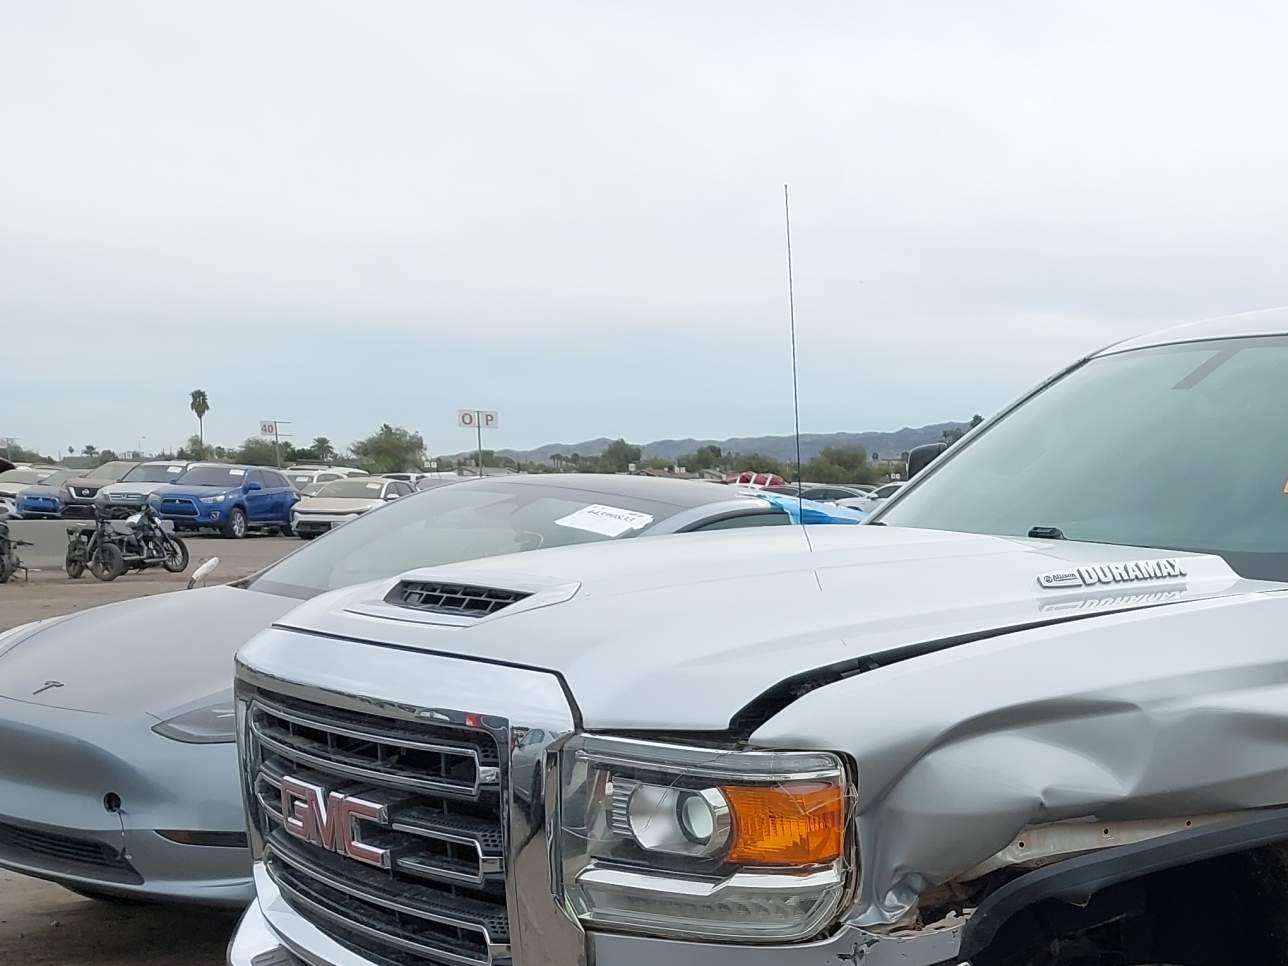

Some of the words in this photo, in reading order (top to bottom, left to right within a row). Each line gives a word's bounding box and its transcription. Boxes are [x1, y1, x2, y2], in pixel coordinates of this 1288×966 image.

[461, 412, 473, 426] O
[485, 414, 494, 426] P
[260, 423, 274, 433] 40
[1077, 558, 1188, 587] DURAMAX
[281, 775, 392, 870] GMC
